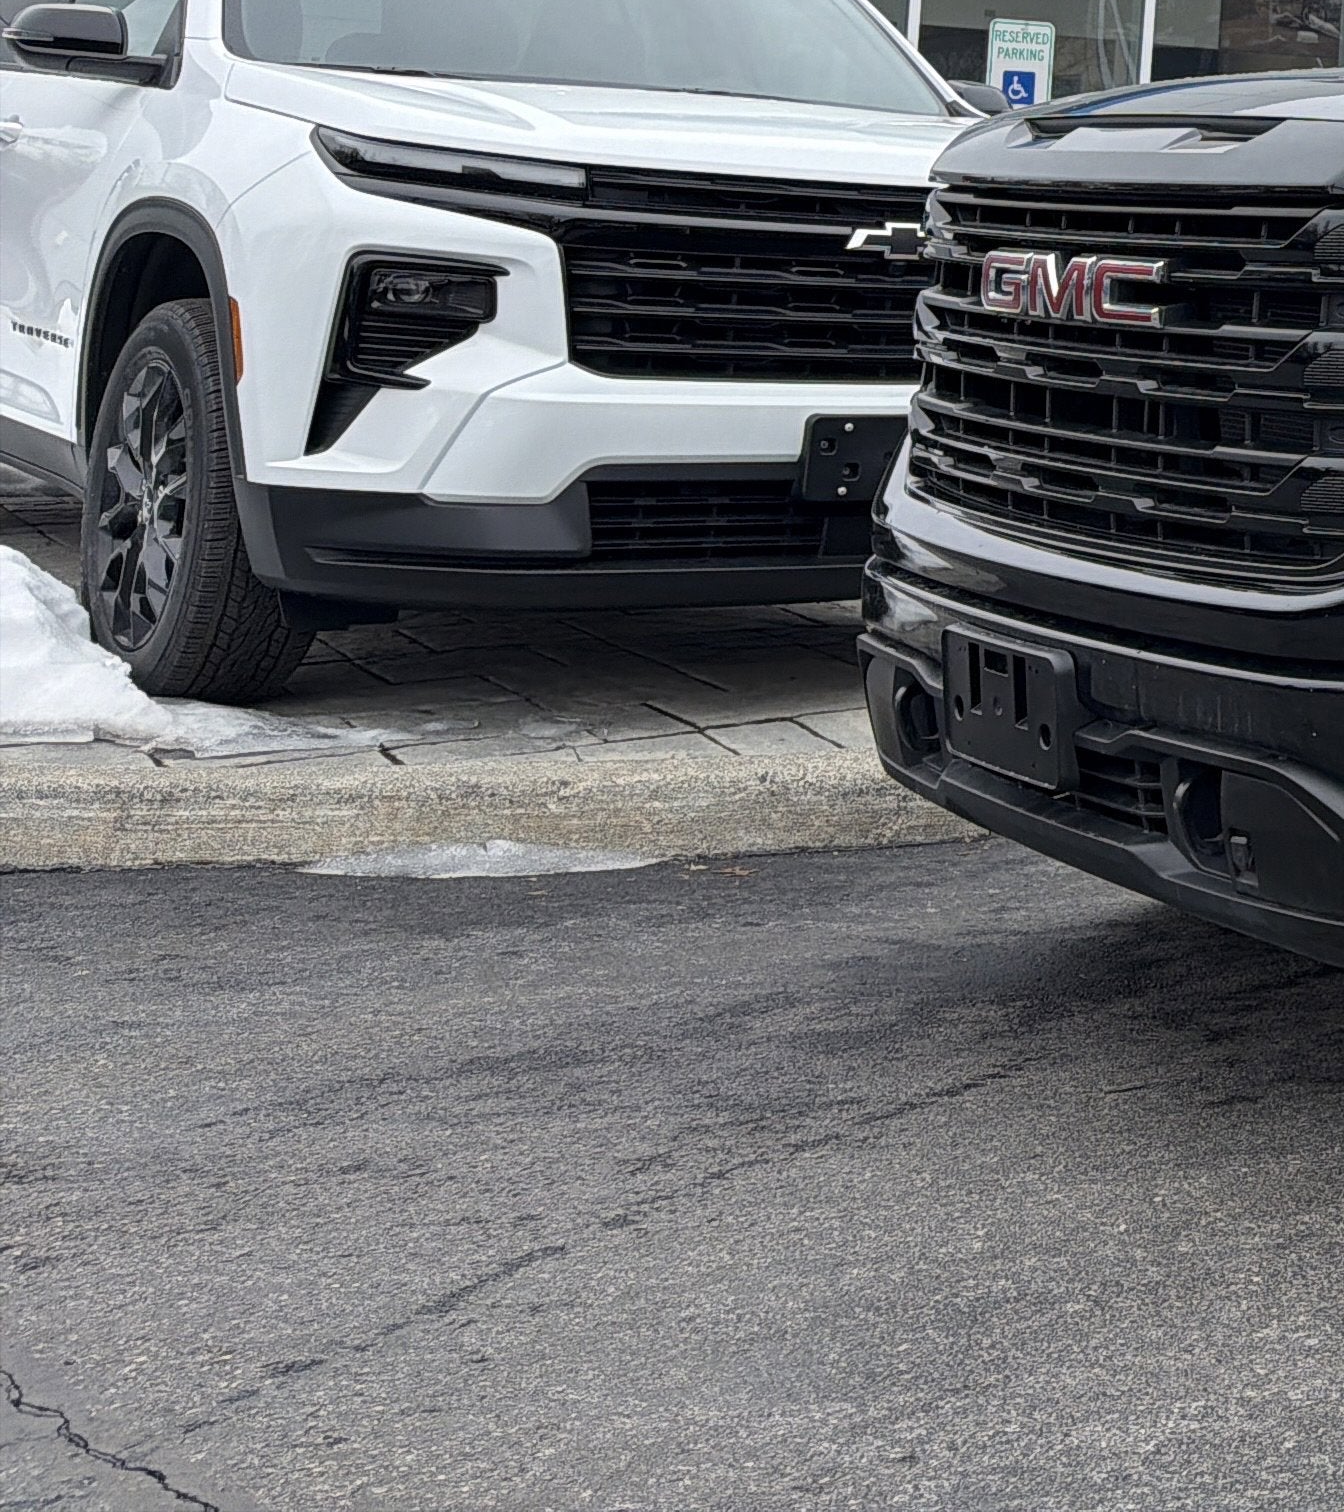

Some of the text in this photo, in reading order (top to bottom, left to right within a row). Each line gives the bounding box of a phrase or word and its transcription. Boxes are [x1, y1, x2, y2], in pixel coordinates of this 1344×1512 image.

[994, 29, 1050, 45] RESERVED
[997, 47, 1045, 62] PARKING
[980, 248, 1165, 329] GMC
[11, 320, 70, 349] TRAVERSE
